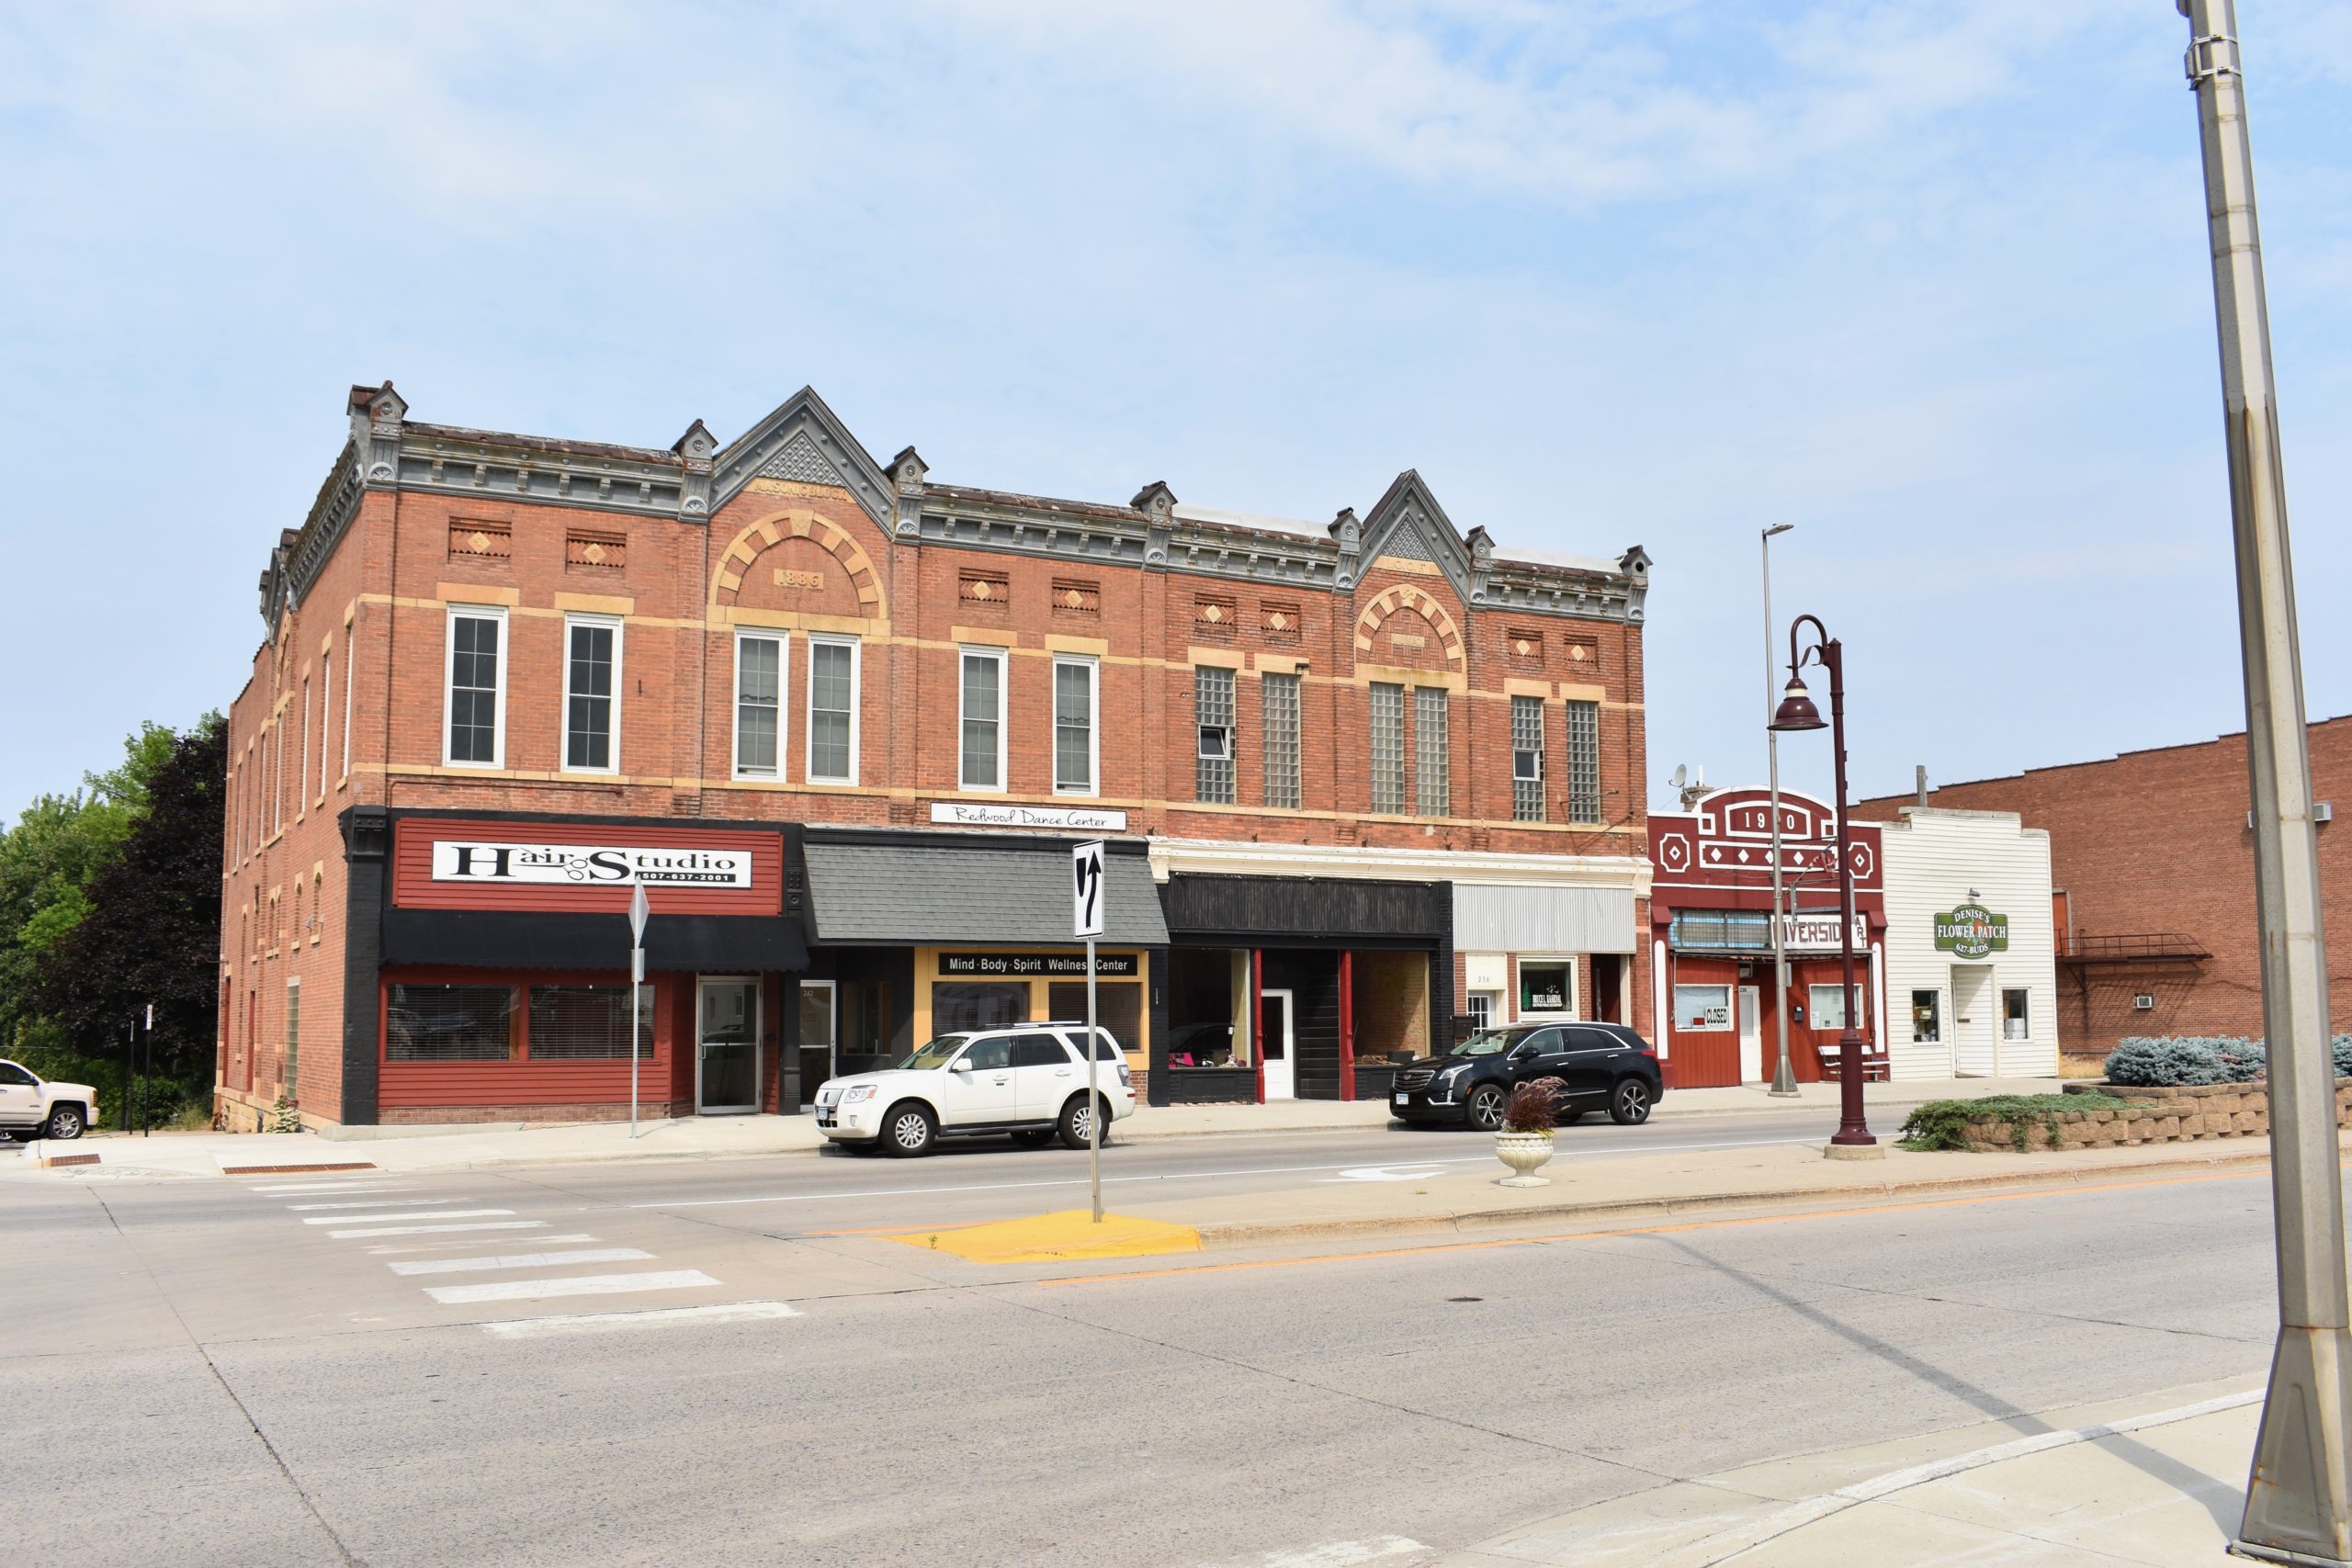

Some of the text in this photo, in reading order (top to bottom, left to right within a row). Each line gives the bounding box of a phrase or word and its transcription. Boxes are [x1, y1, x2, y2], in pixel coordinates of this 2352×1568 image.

[952, 807, 1108, 827] Redwood Dance Center
[1745, 812, 1795, 830] 190
[449, 846, 736, 881] Hair Studio
[643, 873, 729, 882] 507-637-2001
[1954, 908, 1991, 924] DENISE'S
[1772, 921, 1843, 942] IVERSID
[1938, 925, 2007, 939] FLOWER PATCH
[949, 958, 1128, 973] Mind Body Spirit Wellnes Center
[1706, 1008, 1727, 1024] CLOSED
